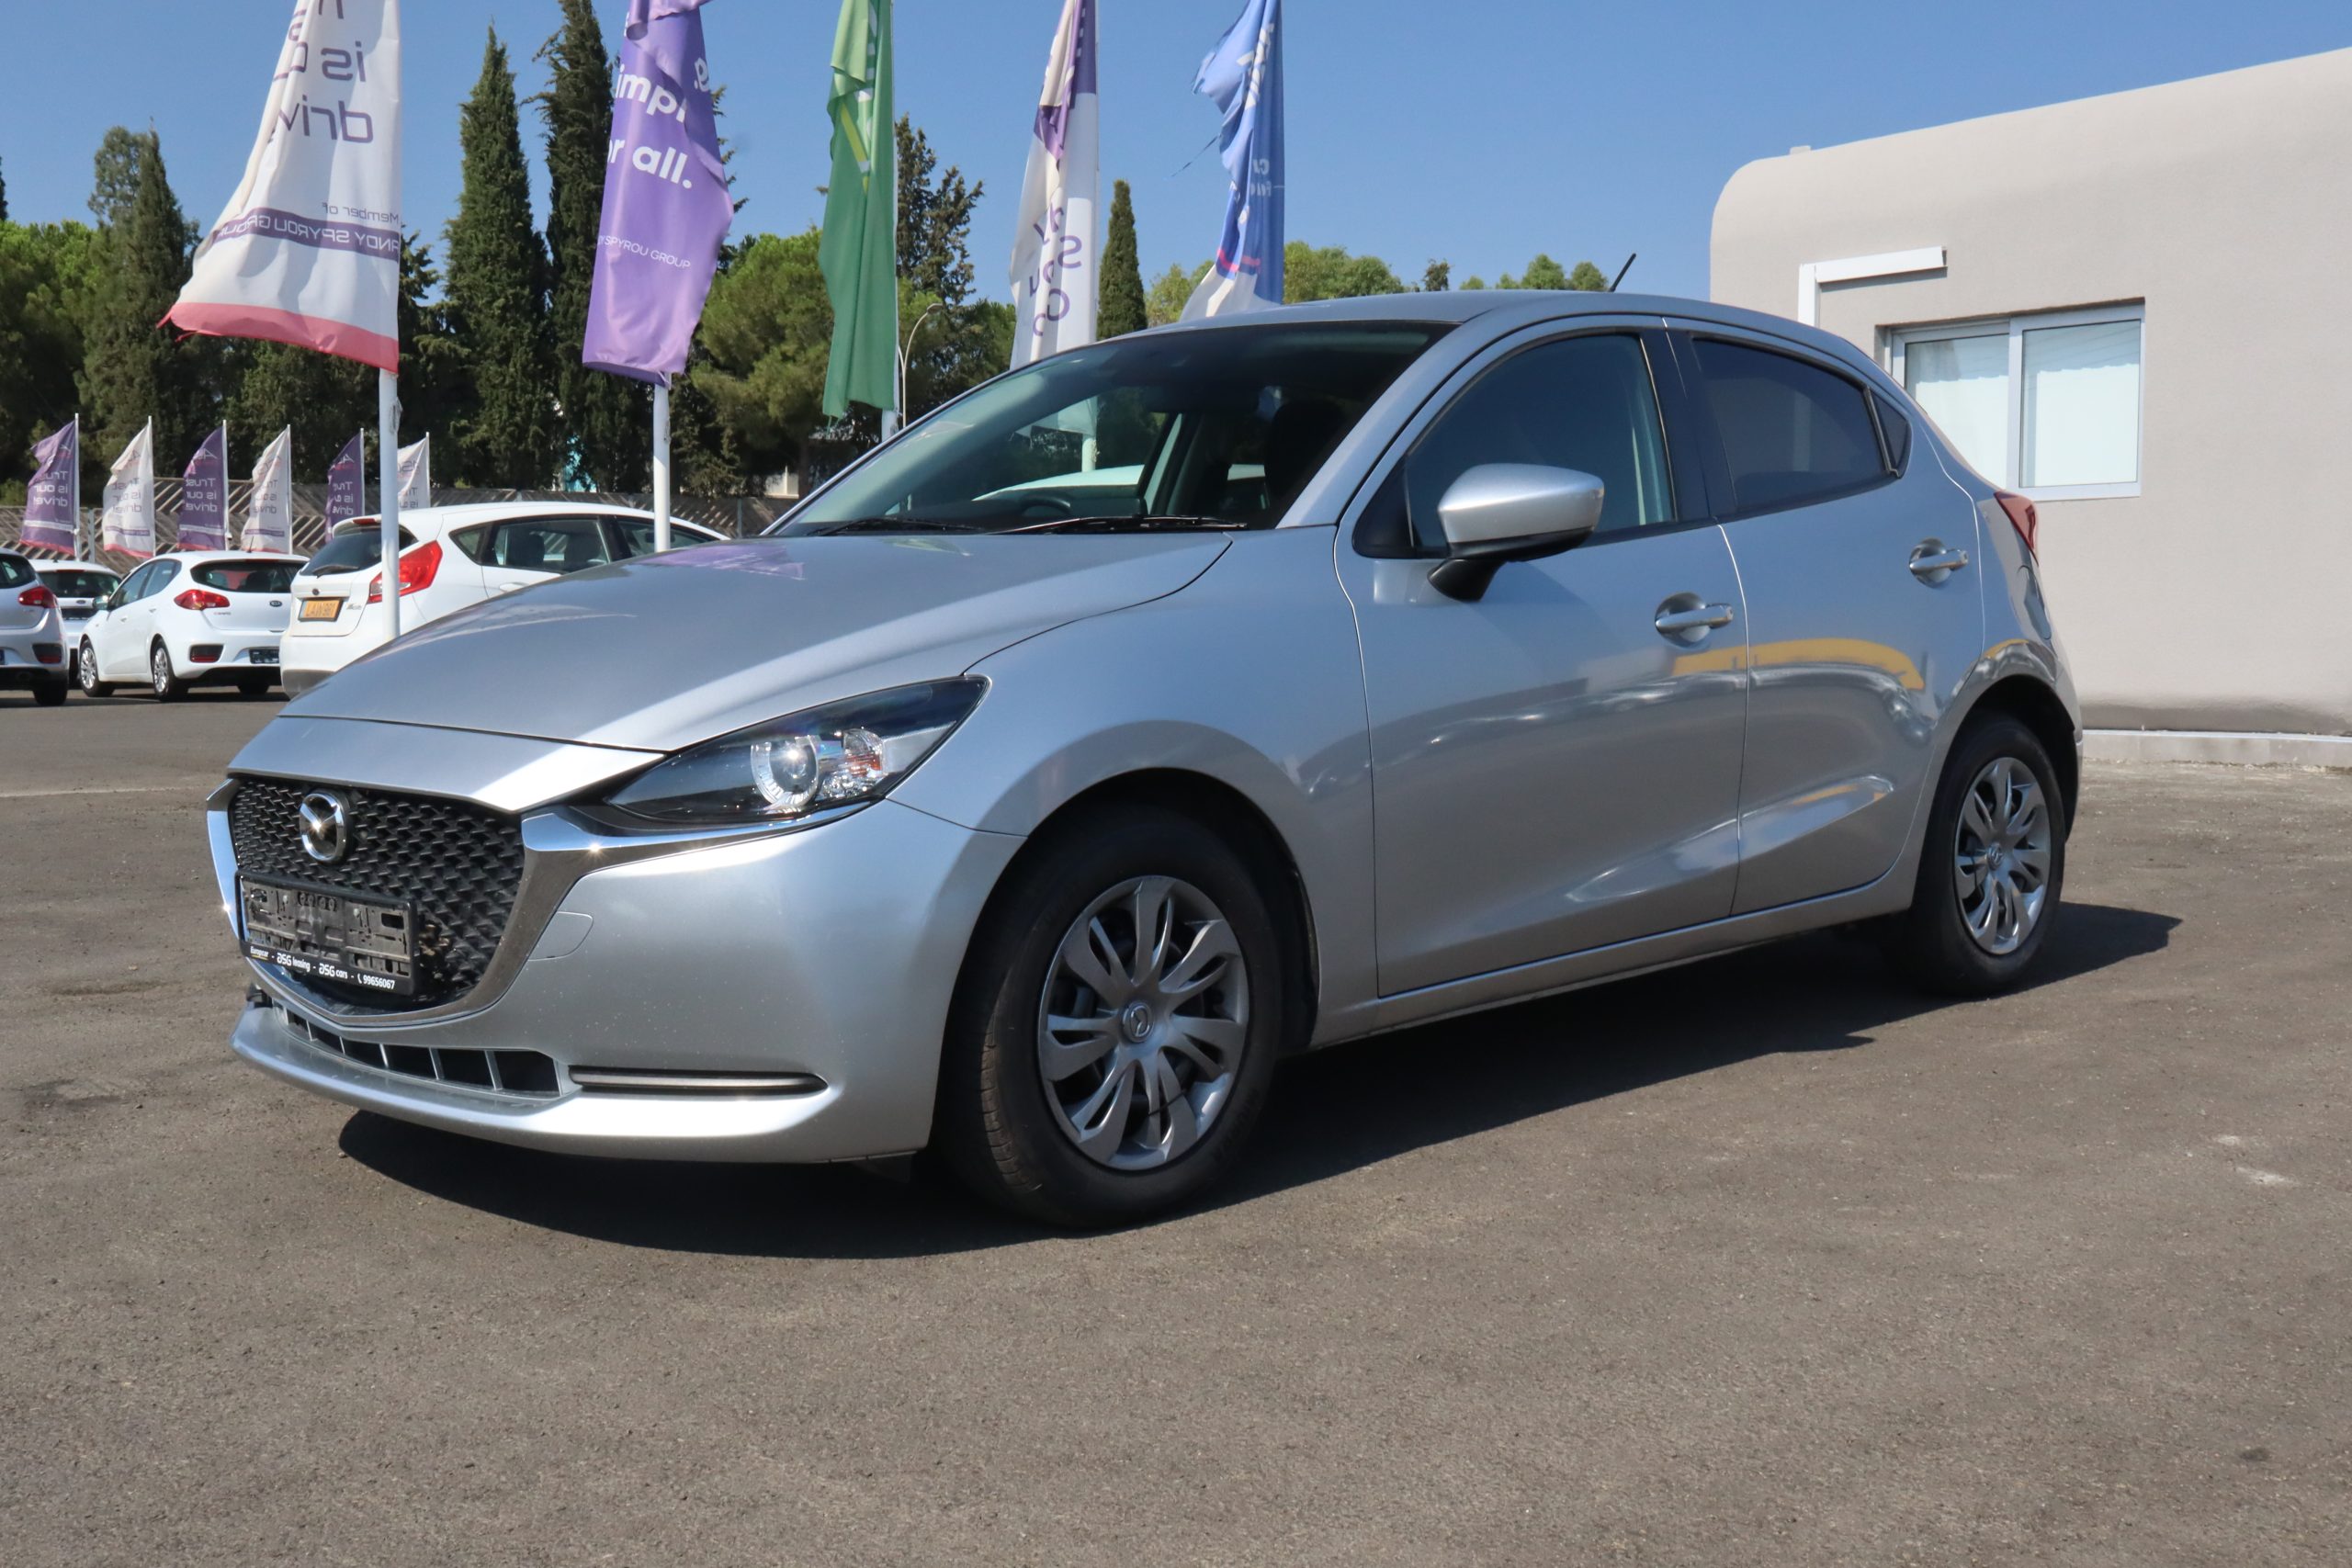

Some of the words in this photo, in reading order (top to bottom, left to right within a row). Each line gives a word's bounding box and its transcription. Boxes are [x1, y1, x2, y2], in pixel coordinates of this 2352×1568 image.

[632, 146, 692, 189] all.
[605, 235, 649, 256] SPYROU
[650, 250, 691, 269] GROUP
[335, 969, 348, 979] cars
